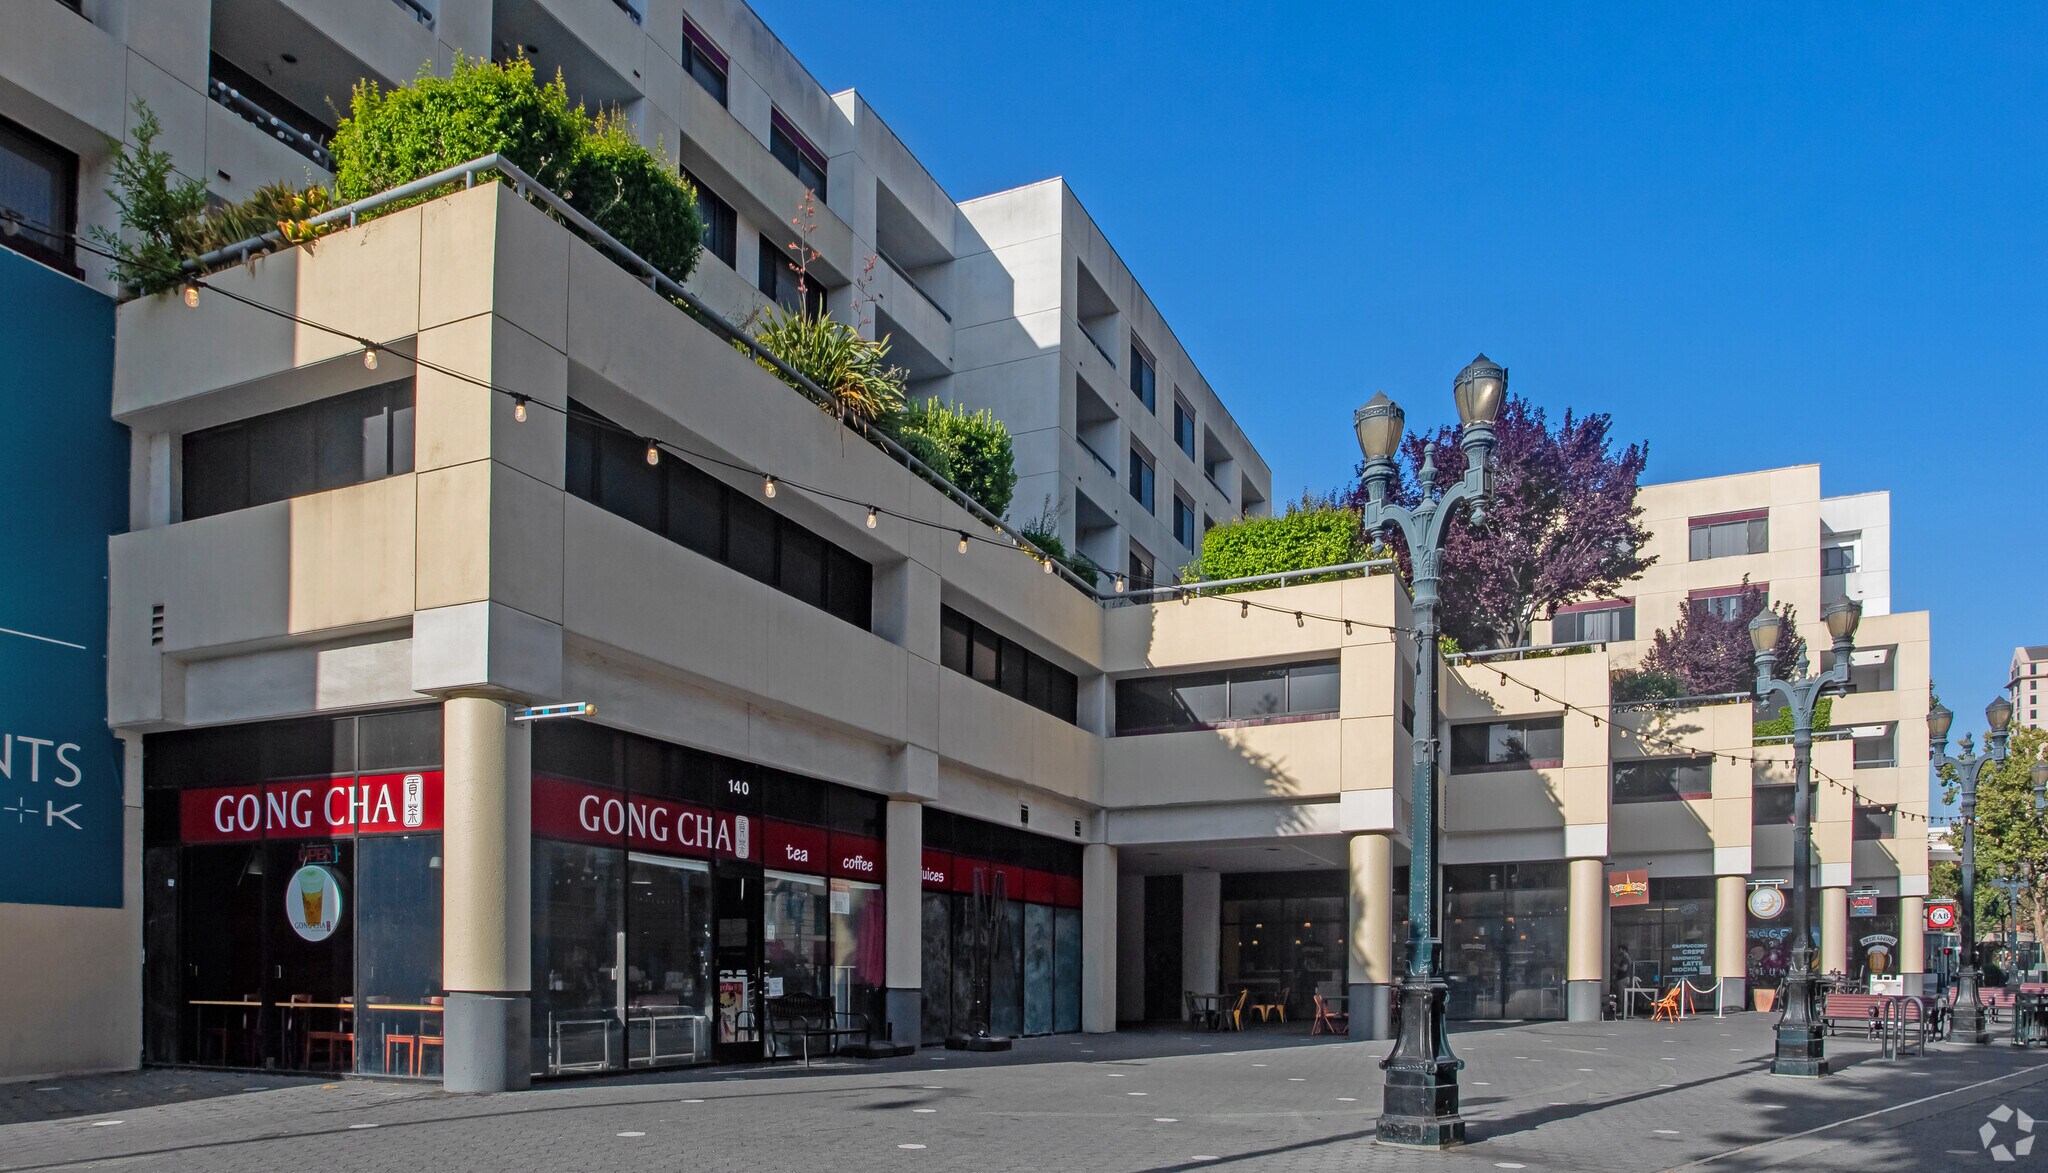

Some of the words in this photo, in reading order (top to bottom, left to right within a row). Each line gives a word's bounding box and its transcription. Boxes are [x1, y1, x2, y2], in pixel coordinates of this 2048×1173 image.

[728, 779, 749, 796] 140
[214, 789, 312, 833] GONG
[324, 784, 396, 826] CHA
[579, 794, 668, 842] GONG
[677, 812, 732, 852] CHA
[786, 844, 808, 862] tea
[842, 855, 873, 872] coffee
